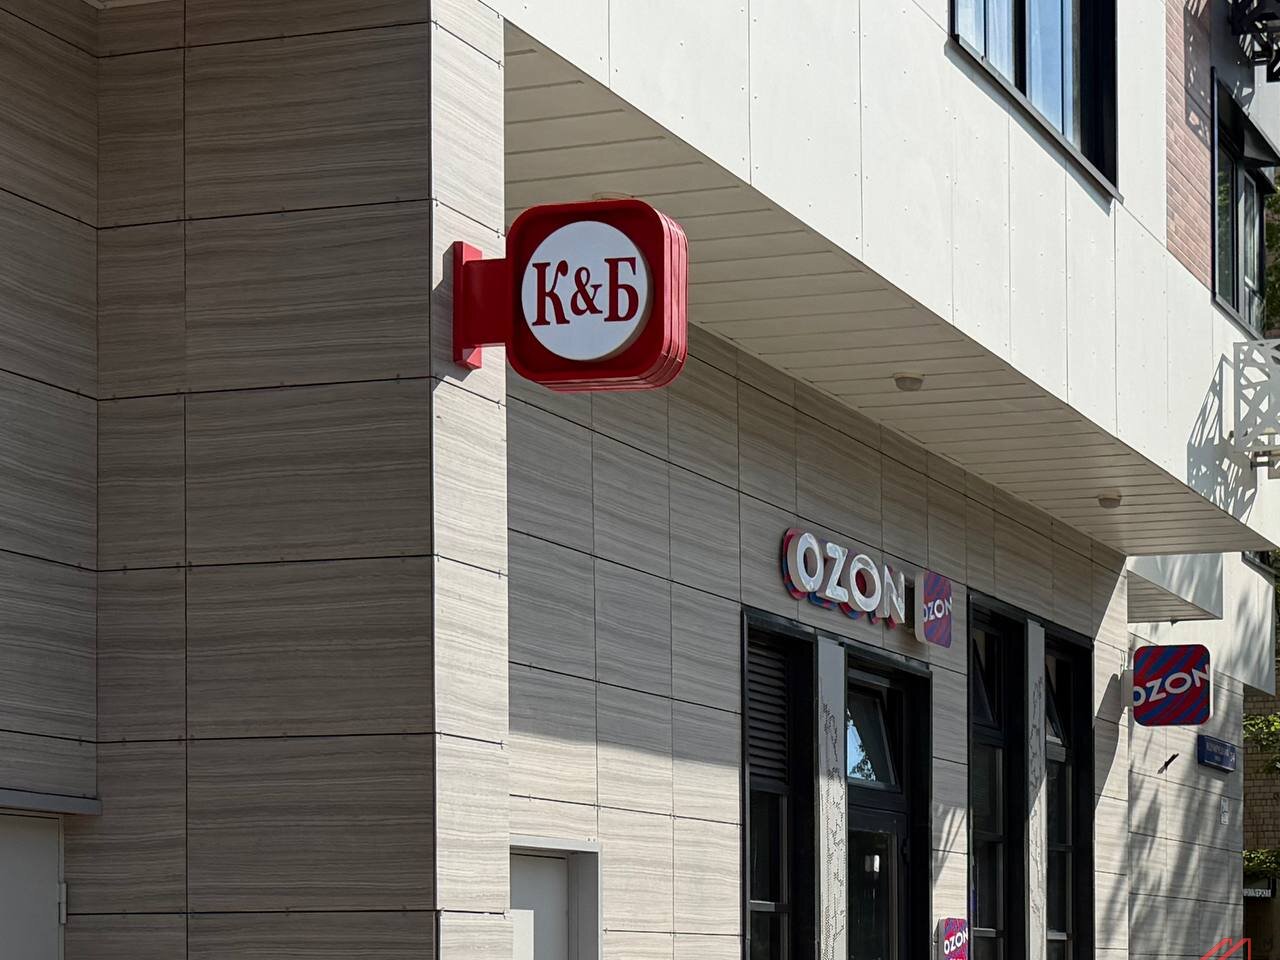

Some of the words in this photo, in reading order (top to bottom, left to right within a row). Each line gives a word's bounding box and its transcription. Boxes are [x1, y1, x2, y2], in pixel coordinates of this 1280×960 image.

[794, 532, 906, 624] OZON
[1133, 664, 1211, 706] OZON
[943, 928, 968, 955] OZON
